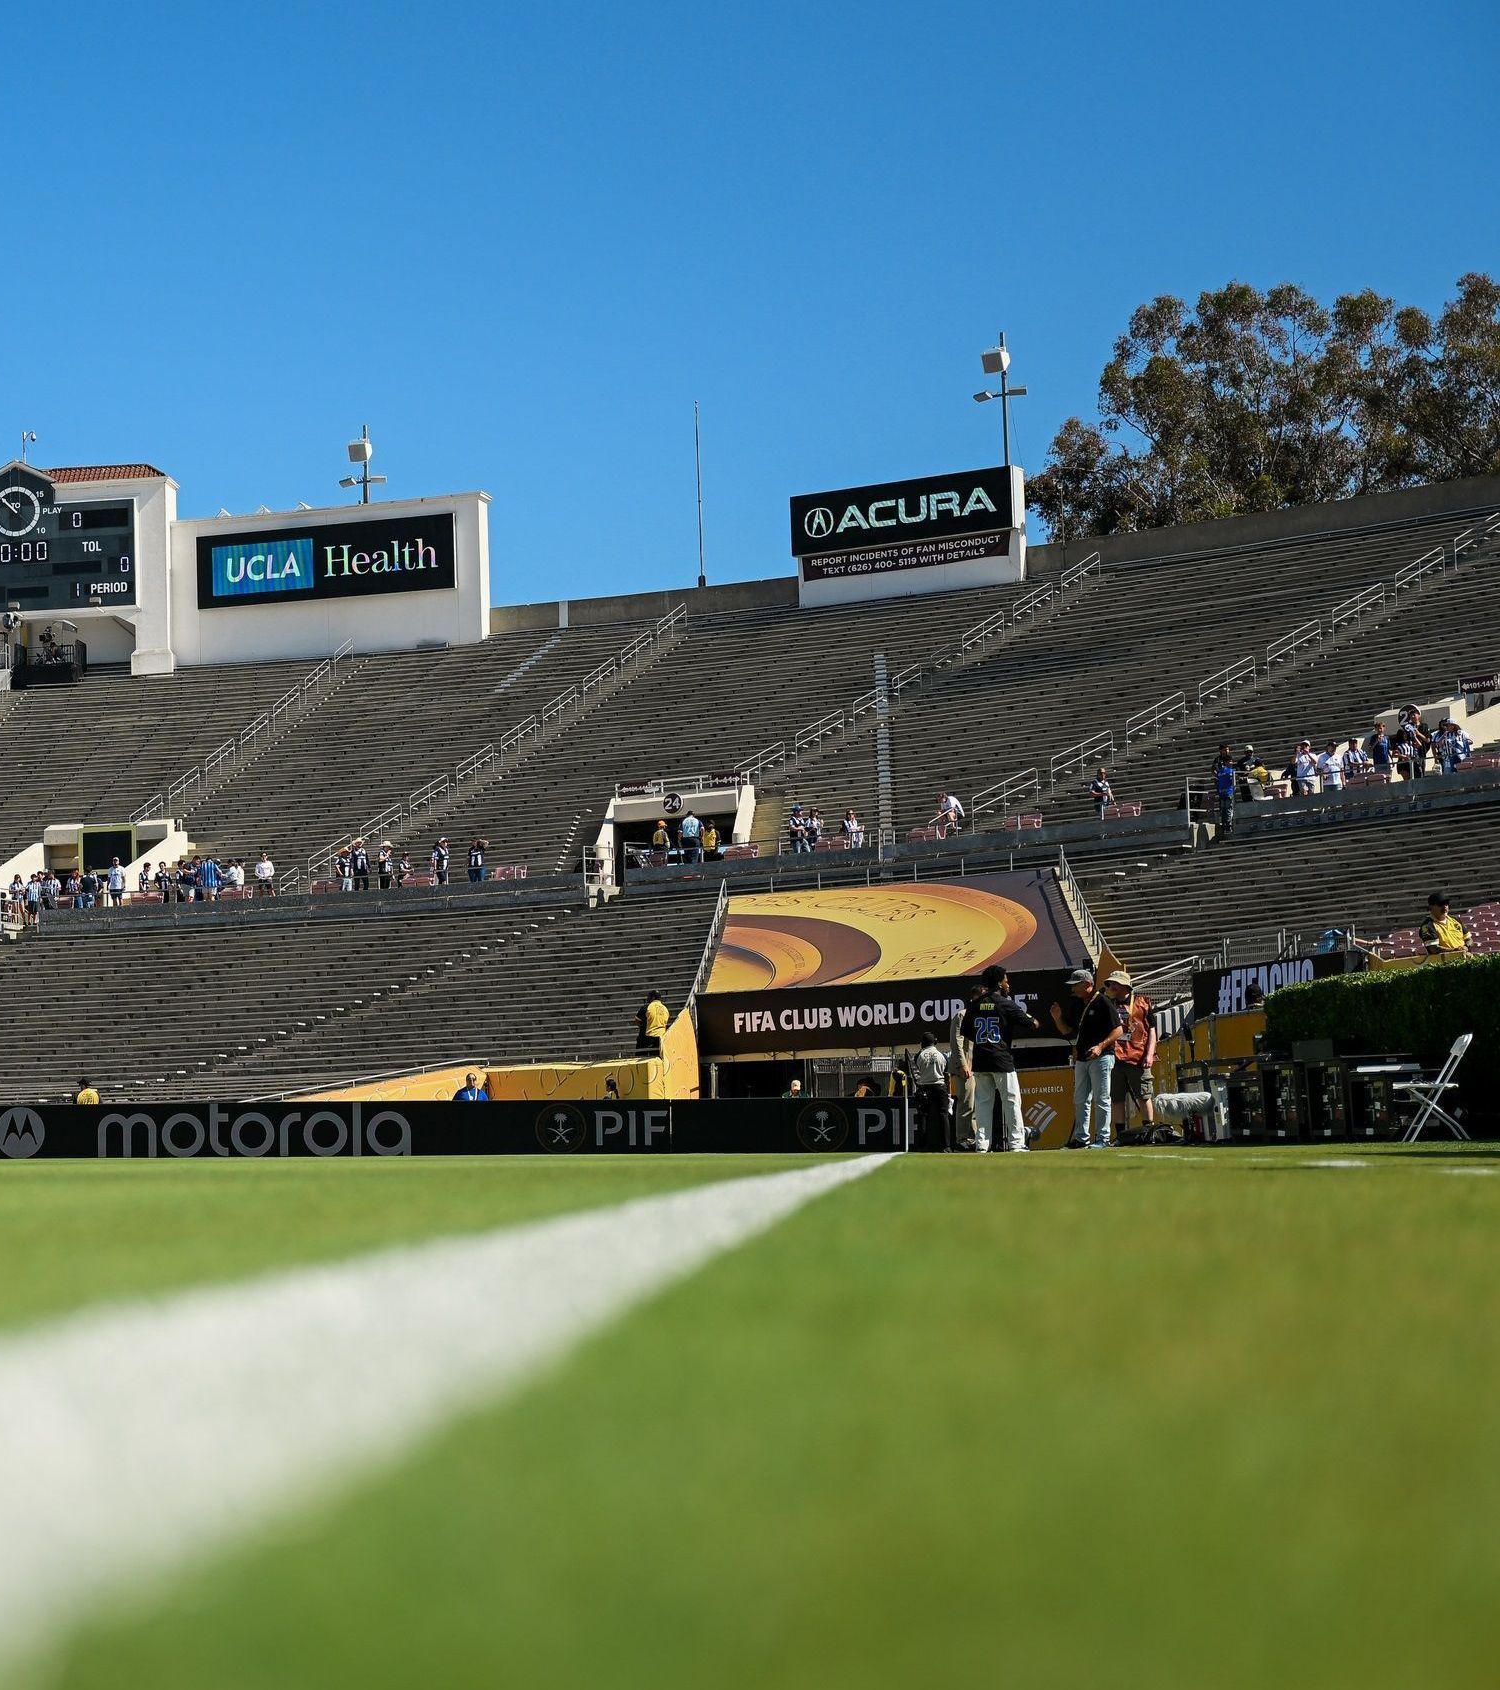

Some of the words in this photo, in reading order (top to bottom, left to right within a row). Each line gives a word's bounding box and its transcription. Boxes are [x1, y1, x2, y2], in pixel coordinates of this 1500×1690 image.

[42, 507, 62, 515] PLAY
[835, 487, 998, 533] ACURA
[82, 541, 102, 552] TOL
[226, 551, 301, 583] UCLA
[323, 538, 439, 577] Health
[811, 555, 849, 567] REPORT
[849, 548, 899, 563] INCIDENTS
[901, 546, 914, 556] OF
[916, 544, 936, 554] FAN
[938, 535, 1001, 550] MISCONDUCT
[822, 566, 845, 575] TEXT
[847, 563, 872, 573] (626)
[874, 560, 897, 569] 400-
[898, 557, 917, 567] 5119
[919, 554, 944, 564] WITH
[947, 547, 985, 560] DETAILS
[90, 582, 128, 594] PERIOD
[664, 797, 681, 810] 24
[733, 1010, 776, 1034] FIFA
[779, 1006, 833, 1031] CLUB
[837, 1001, 915, 1028] WORLD
[919, 998, 965, 1022] CUP
[974, 1016, 1000, 1044] 25
[1039, 1086, 1064, 1094] AMERICA
[97, 1102, 412, 1157] motorola
[594, 1110, 669, 1146] PIF
